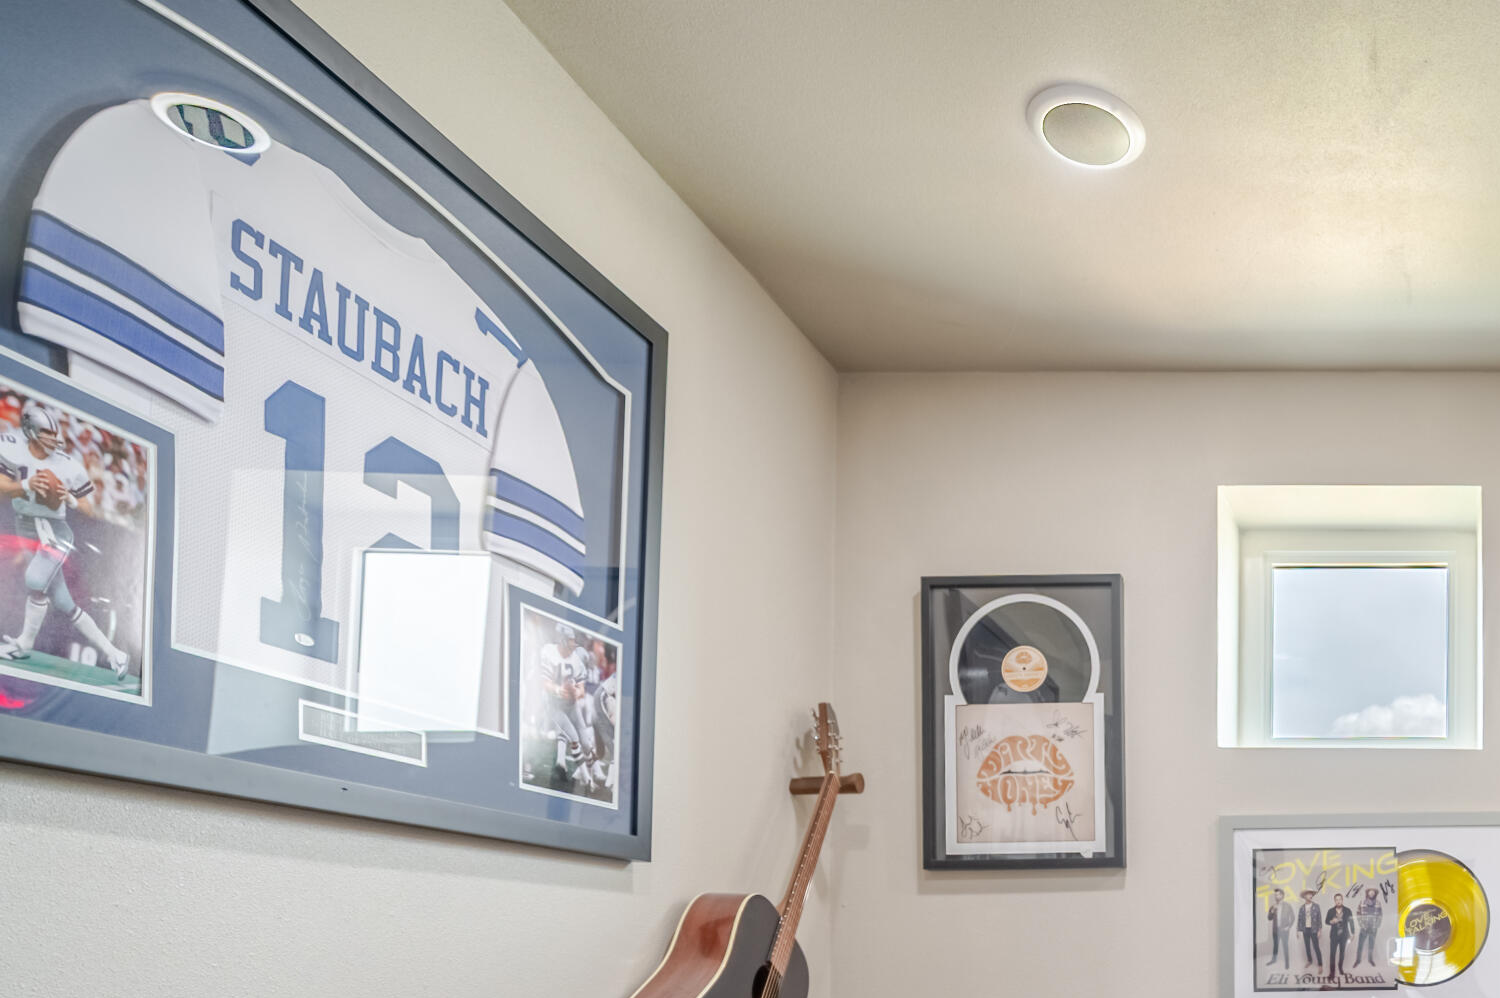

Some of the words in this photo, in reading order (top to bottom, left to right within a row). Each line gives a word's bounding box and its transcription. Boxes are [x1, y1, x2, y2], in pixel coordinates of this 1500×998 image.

[230, 218, 490, 439] STAUBACH
[976, 735, 1072, 780] DIRTY
[976, 774, 1075, 815] HONEY
[1266, 973, 1289, 985] Eli
[1294, 973, 1341, 987] Young
[1343, 972, 1386, 985] Band
